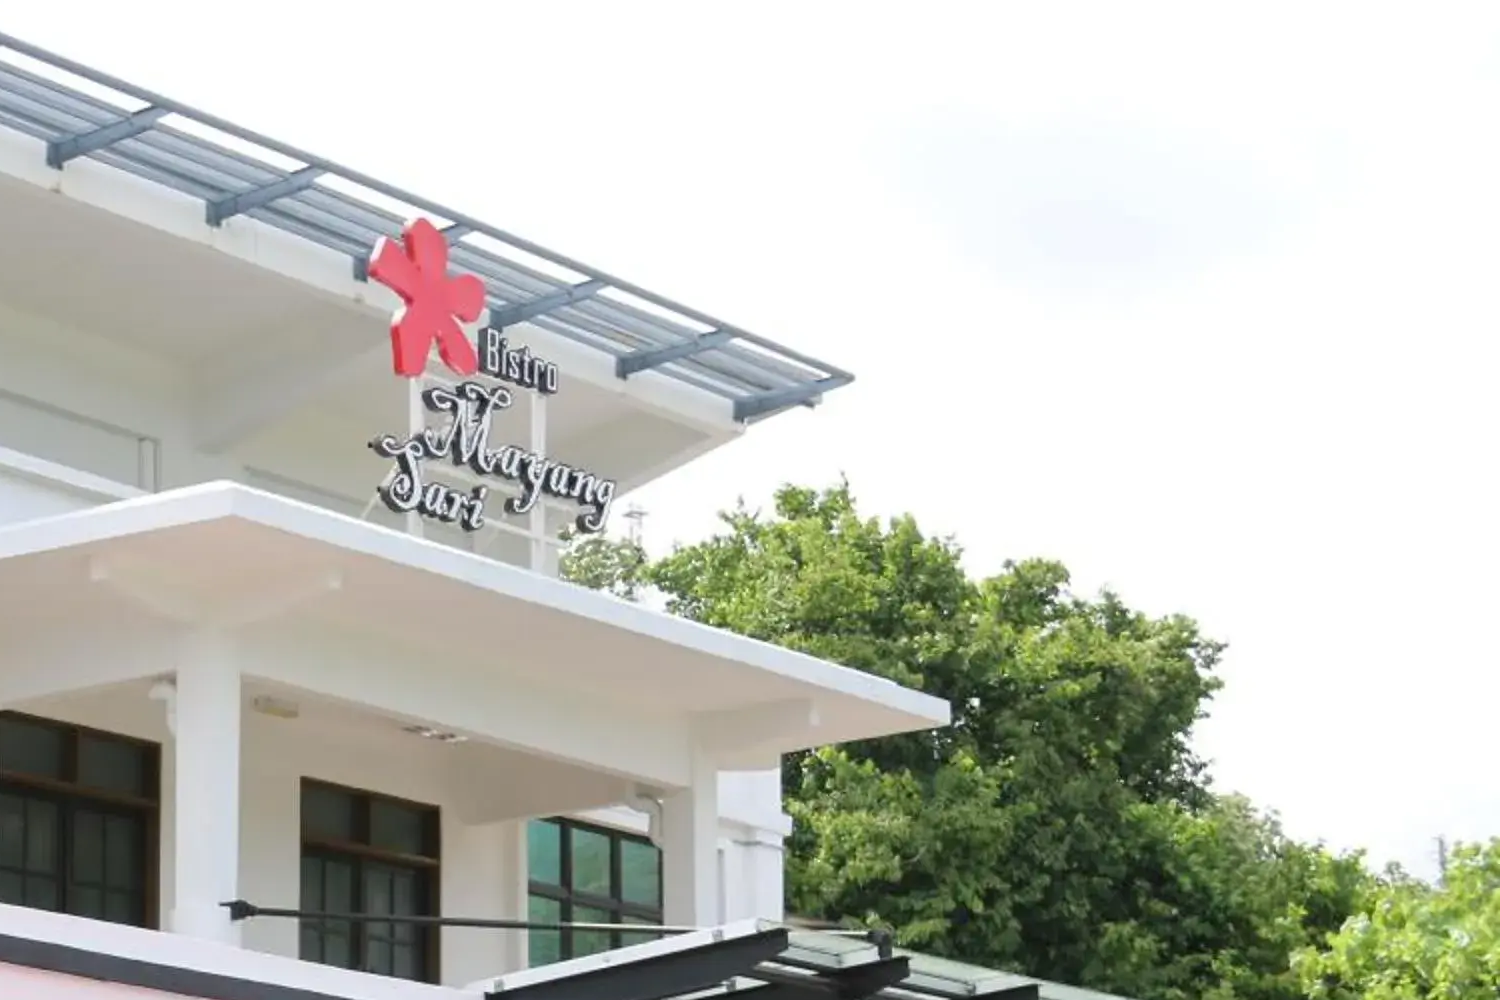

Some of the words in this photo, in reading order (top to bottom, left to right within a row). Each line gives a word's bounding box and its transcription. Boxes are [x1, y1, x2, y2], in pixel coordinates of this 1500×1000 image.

[479, 325, 558, 394] Bistro
[372, 435, 487, 532] Sari
[423, 382, 616, 534] Mayang
